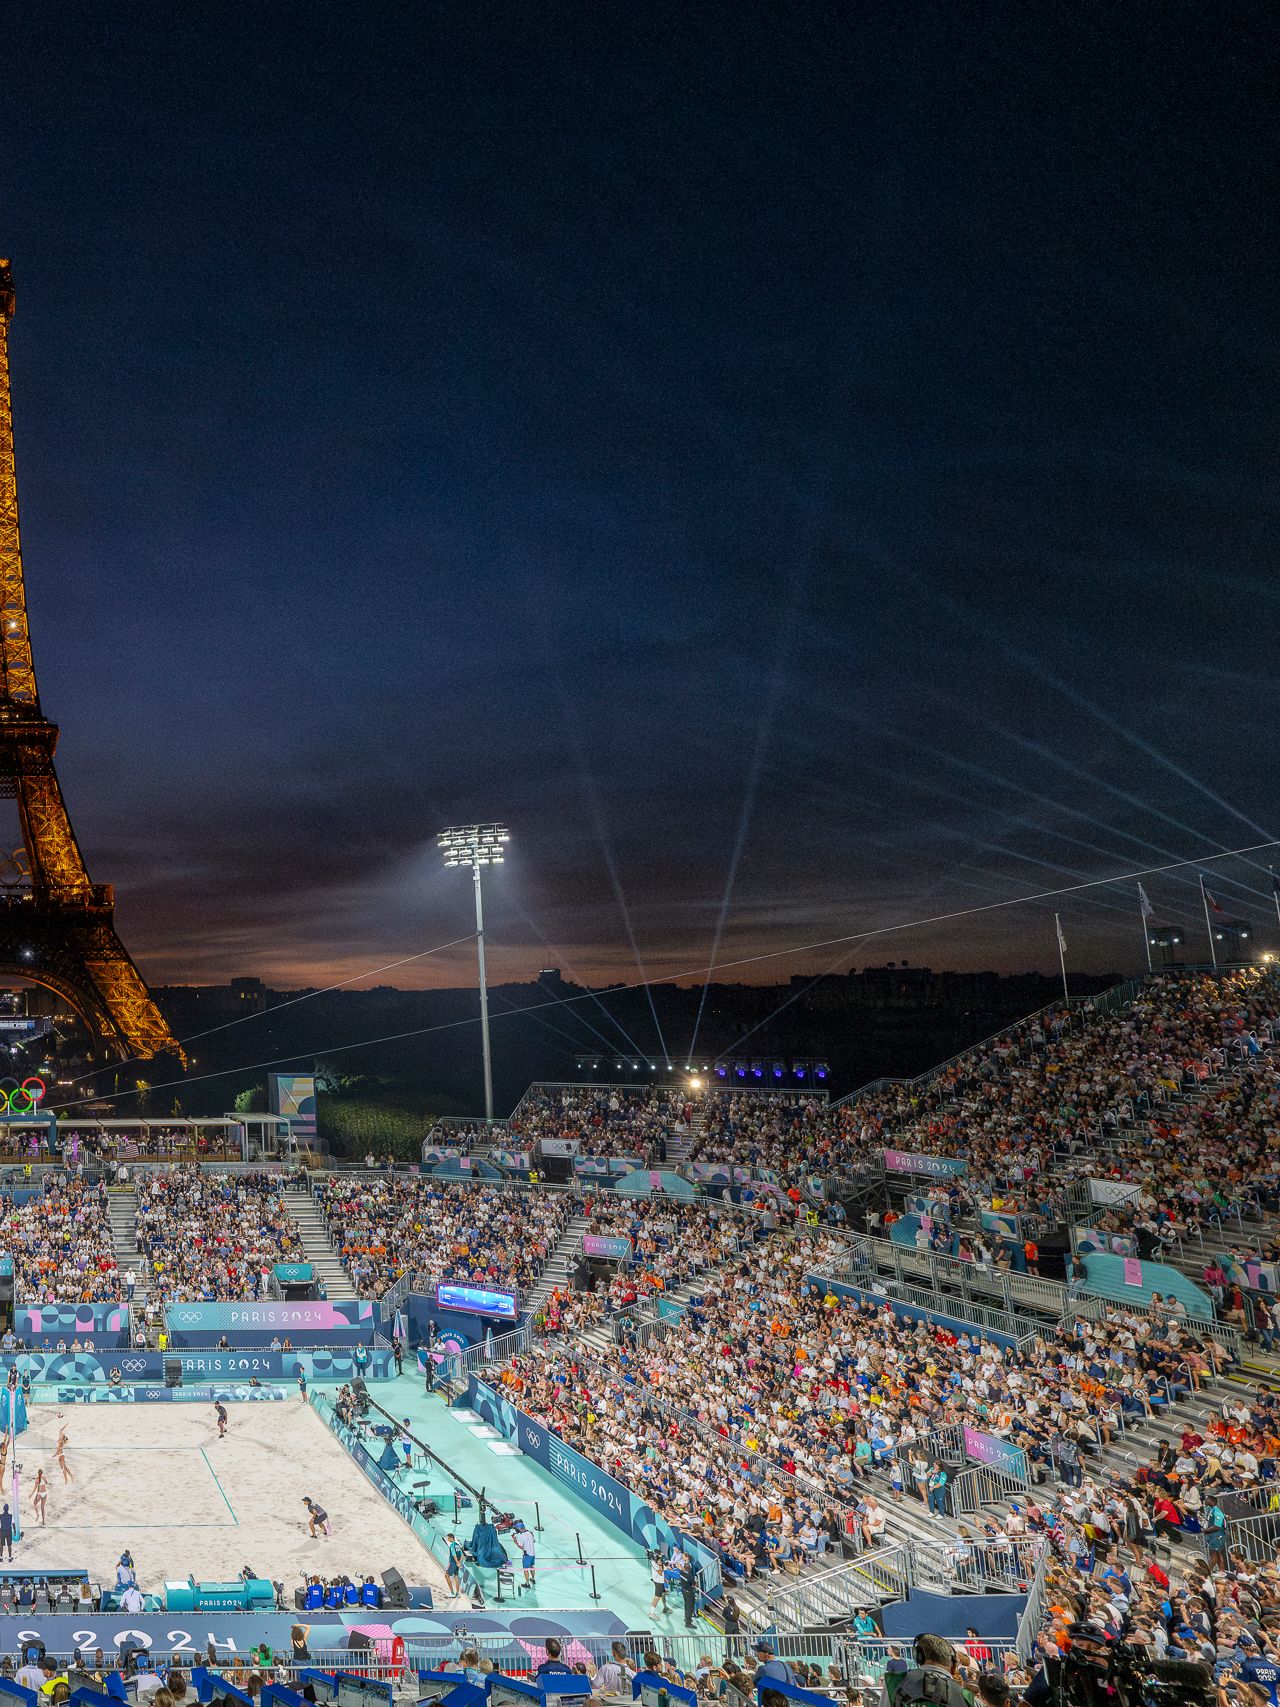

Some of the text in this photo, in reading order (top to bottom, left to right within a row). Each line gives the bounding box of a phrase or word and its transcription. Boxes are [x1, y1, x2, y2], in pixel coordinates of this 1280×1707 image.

[895, 1156, 923, 1169] PARIS
[232, 1312, 322, 1322] PARIS 2024
[181, 1359, 270, 1370] ARIS 2024
[968, 1438, 994, 1455] PARIS
[556, 1453, 622, 1515] PARIS 2024
[73, 1630, 238, 1651] 2024
